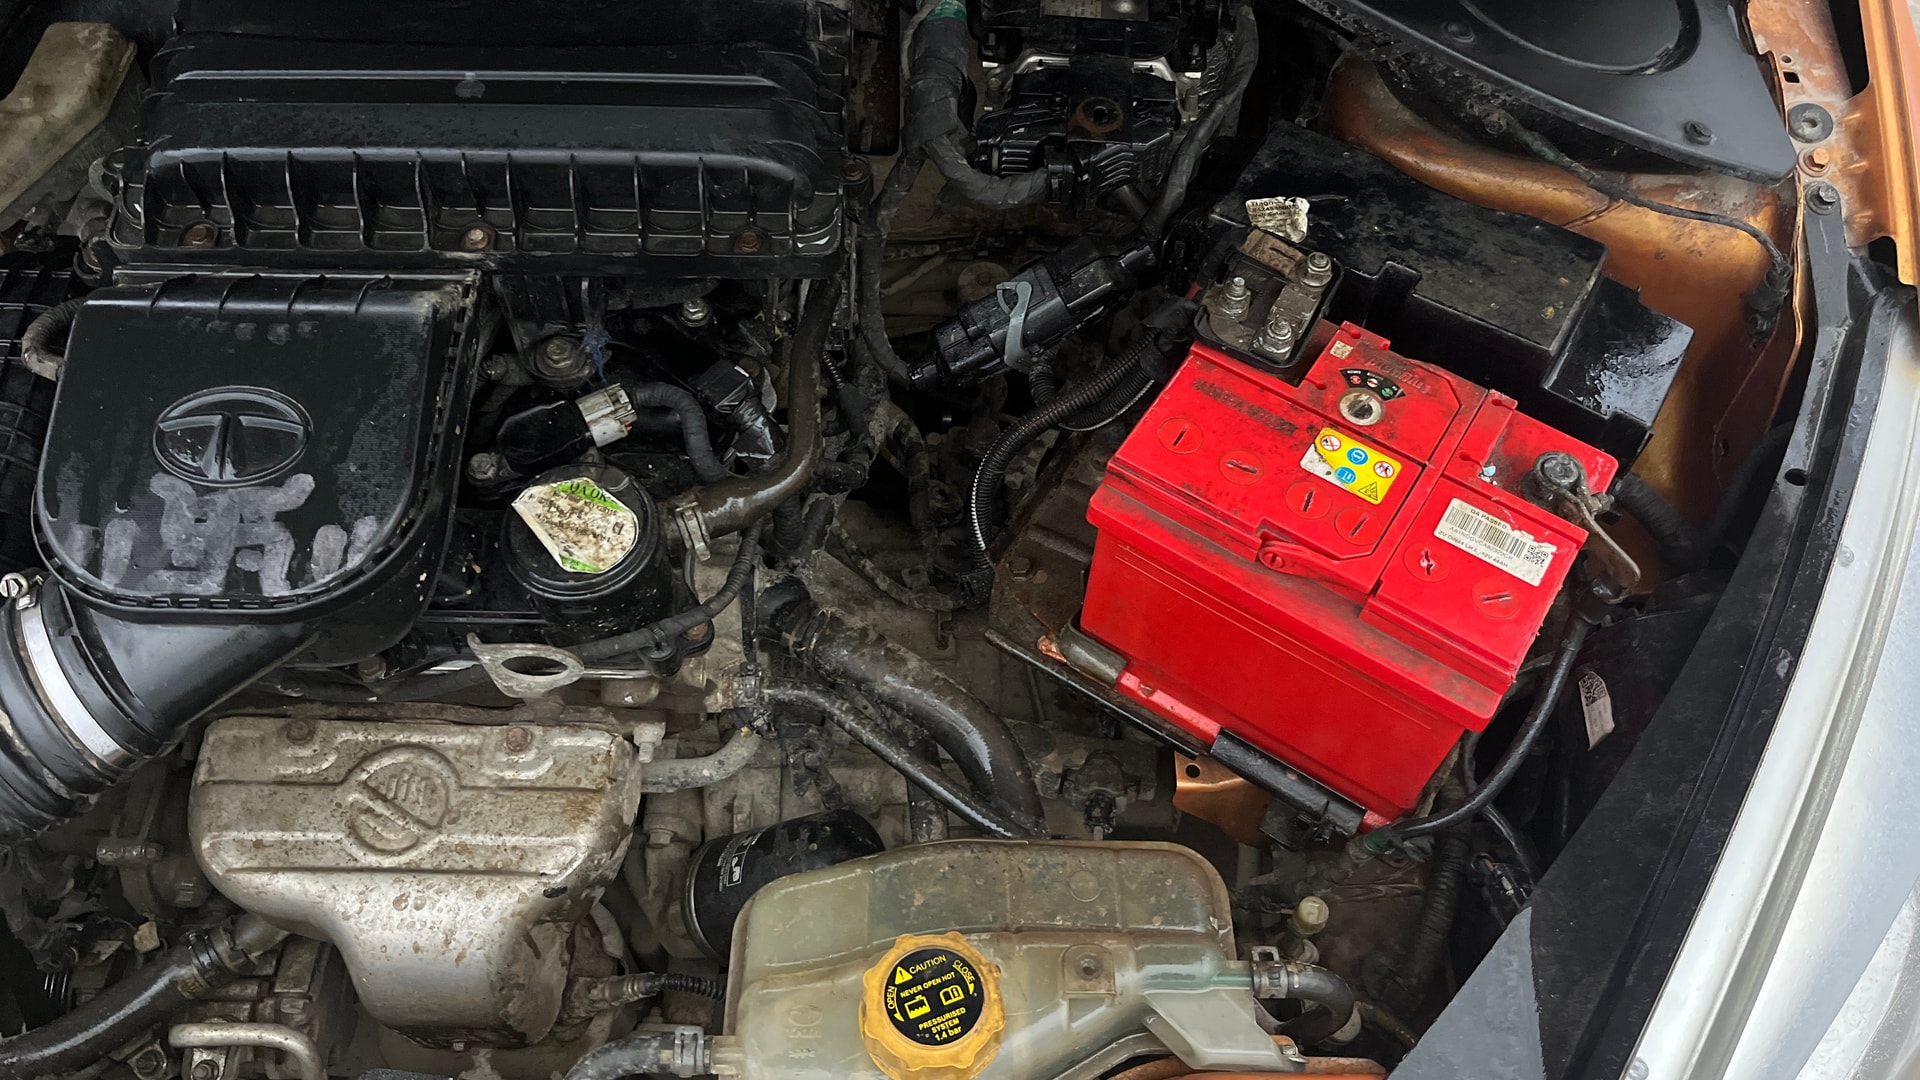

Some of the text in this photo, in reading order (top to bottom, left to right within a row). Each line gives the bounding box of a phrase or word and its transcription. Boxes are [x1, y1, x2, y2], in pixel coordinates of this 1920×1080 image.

[570, 481, 607, 502] QA OK
[1470, 508, 1507, 529] QA PASSED
[909, 955, 946, 974] CAUTION
[953, 959, 976, 983] CLOSE
[900, 972, 956, 998] NEVER OPEN HOT
[887, 986, 895, 1009] OPEN
[918, 1007, 967, 1031] PRESSURISED
[931, 1018, 960, 1034] SYSTEM
[935, 1026, 962, 1041] 1.4 bar
